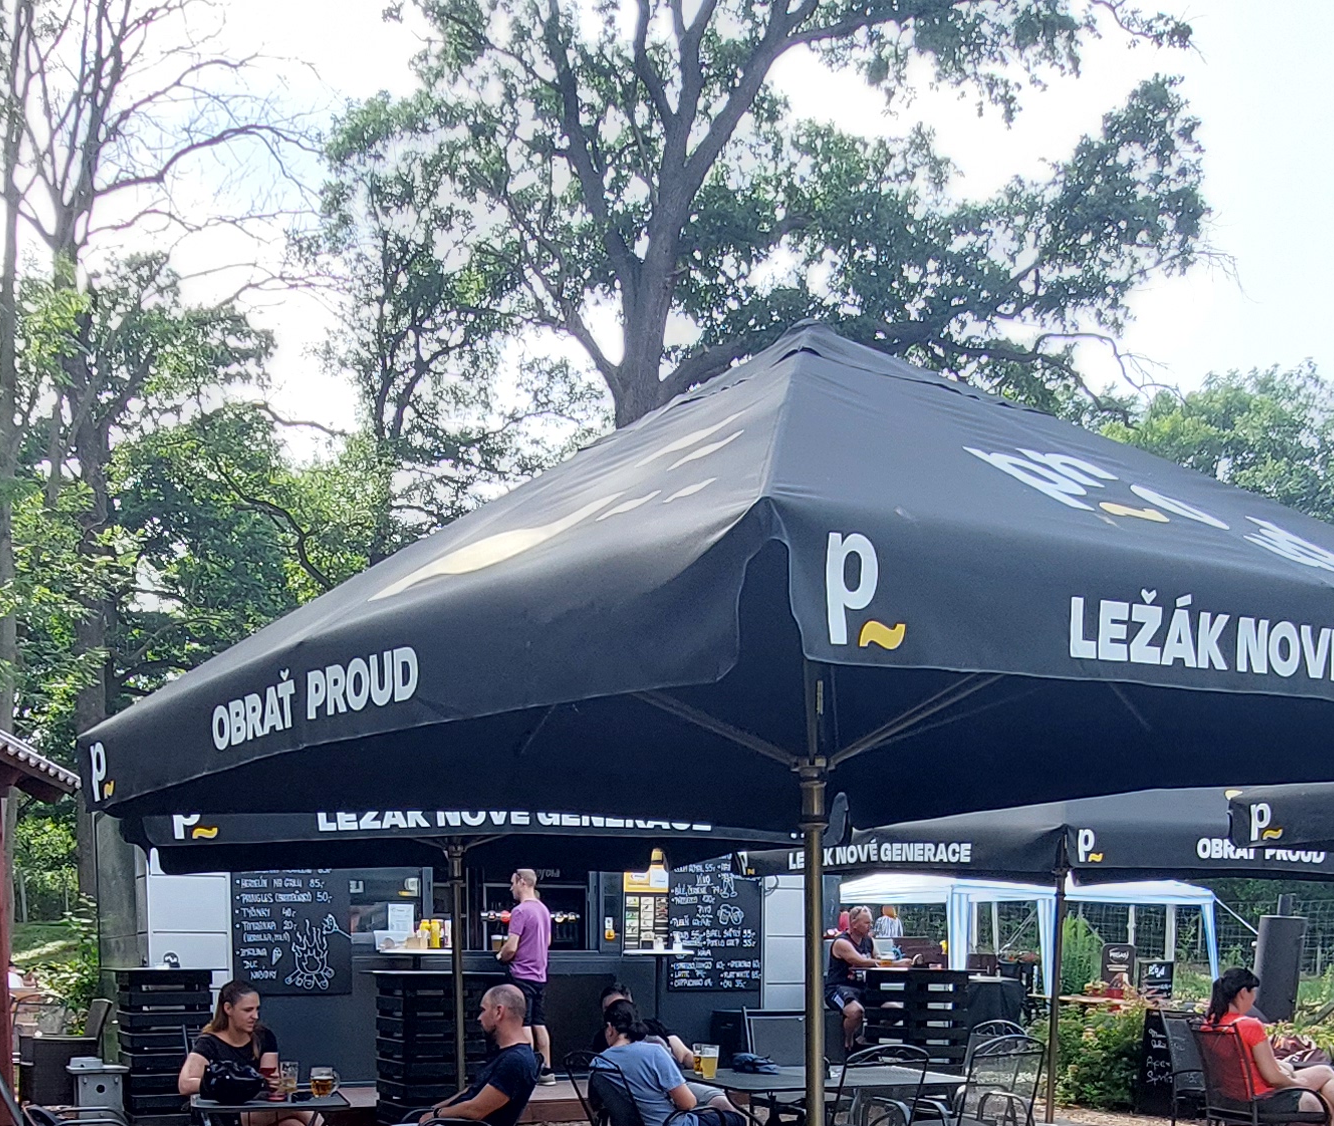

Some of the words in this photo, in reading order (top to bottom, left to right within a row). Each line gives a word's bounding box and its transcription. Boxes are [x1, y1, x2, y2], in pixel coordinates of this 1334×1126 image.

[1069, 588, 1230, 671] LEŽÁK
[211, 668, 296, 751] OBRAŤ
[306, 646, 419, 721] PROUD
[836, 838, 878, 865] NOVÉ
[879, 842, 972, 864] GENERACE
